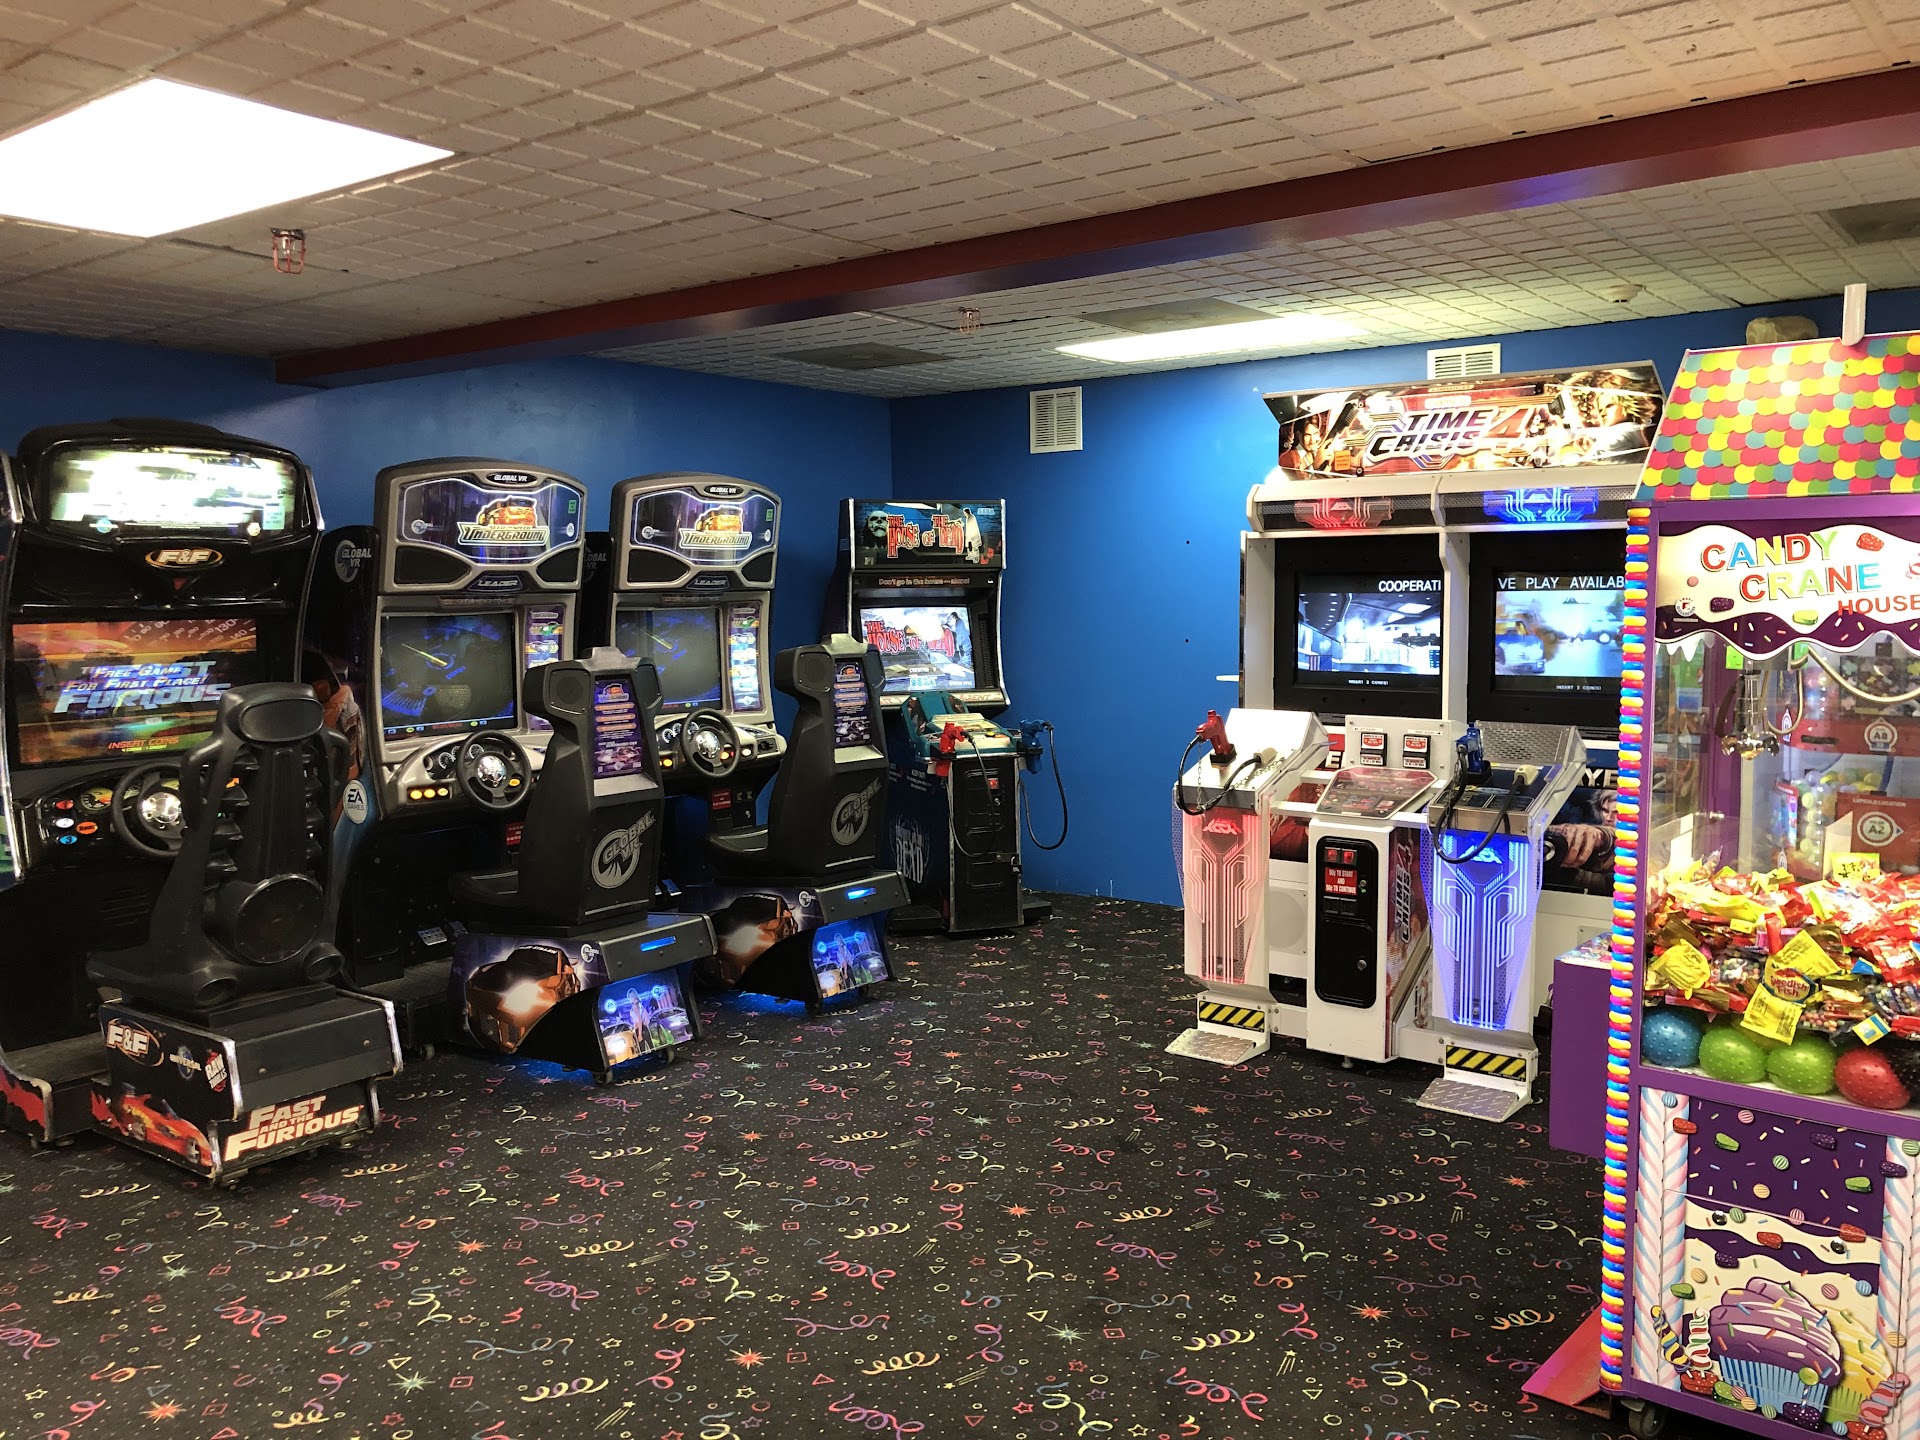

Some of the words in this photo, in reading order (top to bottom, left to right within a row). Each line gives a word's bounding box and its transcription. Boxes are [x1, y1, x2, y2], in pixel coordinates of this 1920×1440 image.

[1408, 409, 1494, 431] TIME
[1486, 409, 1532, 438] 4
[1369, 430, 1481, 457] CRISIS
[887, 515, 904, 527] THE
[932, 515, 949, 528] THE
[887, 523, 920, 558] HOUSE
[922, 530, 936, 546] OF
[939, 522, 965, 554] DEAD
[158, 549, 212, 564] F&F
[342, 548, 372, 558] GLOBAL
[584, 552, 607, 562] LOBAL
[1701, 530, 1838, 572] CANDY
[350, 558, 361, 567] VR
[478, 579, 518, 587] LEADER
[1379, 579, 1442, 592] COOPERATI
[1498, 577, 1516, 589] VE
[1526, 576, 1559, 589] PLAY
[1570, 575, 1625, 588] AVAILAB
[1740, 563, 1882, 602] CRANE
[1837, 594, 1920, 617] HOUSE
[865, 620, 885, 633] THE
[867, 628, 906, 655] HOUSE
[910, 635, 922, 650] OF
[92, 666, 132, 679] FREE
[138, 665, 182, 677] GAME
[65, 681, 97, 693] FOR
[103, 678, 149, 693] FIRST
[152, 675, 207, 691] PLACE!
[54, 683, 231, 714] FURIOUS
[108, 740, 144, 750] INSERT
[146, 737, 179, 747] COINS
[348, 789, 364, 804] EA
[841, 777, 881, 824] GLOBAL
[603, 810, 655, 864] GLOBAL
[619, 836, 643, 862] VR
[1336, 869, 1341, 877] TO
[1342, 870, 1353, 878] START
[1337, 877, 1346, 885] AND
[1333, 884, 1338, 892] TO
[1338, 885, 1357, 894] CONTINUE
[1395, 864, 1404, 924] TIME
[1402, 871, 1411, 943] CRISIS
[1770, 975, 1808, 991] Swedish
[1777, 986, 1800, 997] Fish
[107, 1023, 150, 1057] F&F
[205, 1053, 225, 1081] RAW
[249, 1095, 327, 1130] FAST
[224, 1105, 365, 1161] FURIOUS
[260, 1119, 287, 1134] AND
[288, 1112, 315, 1125] THE
